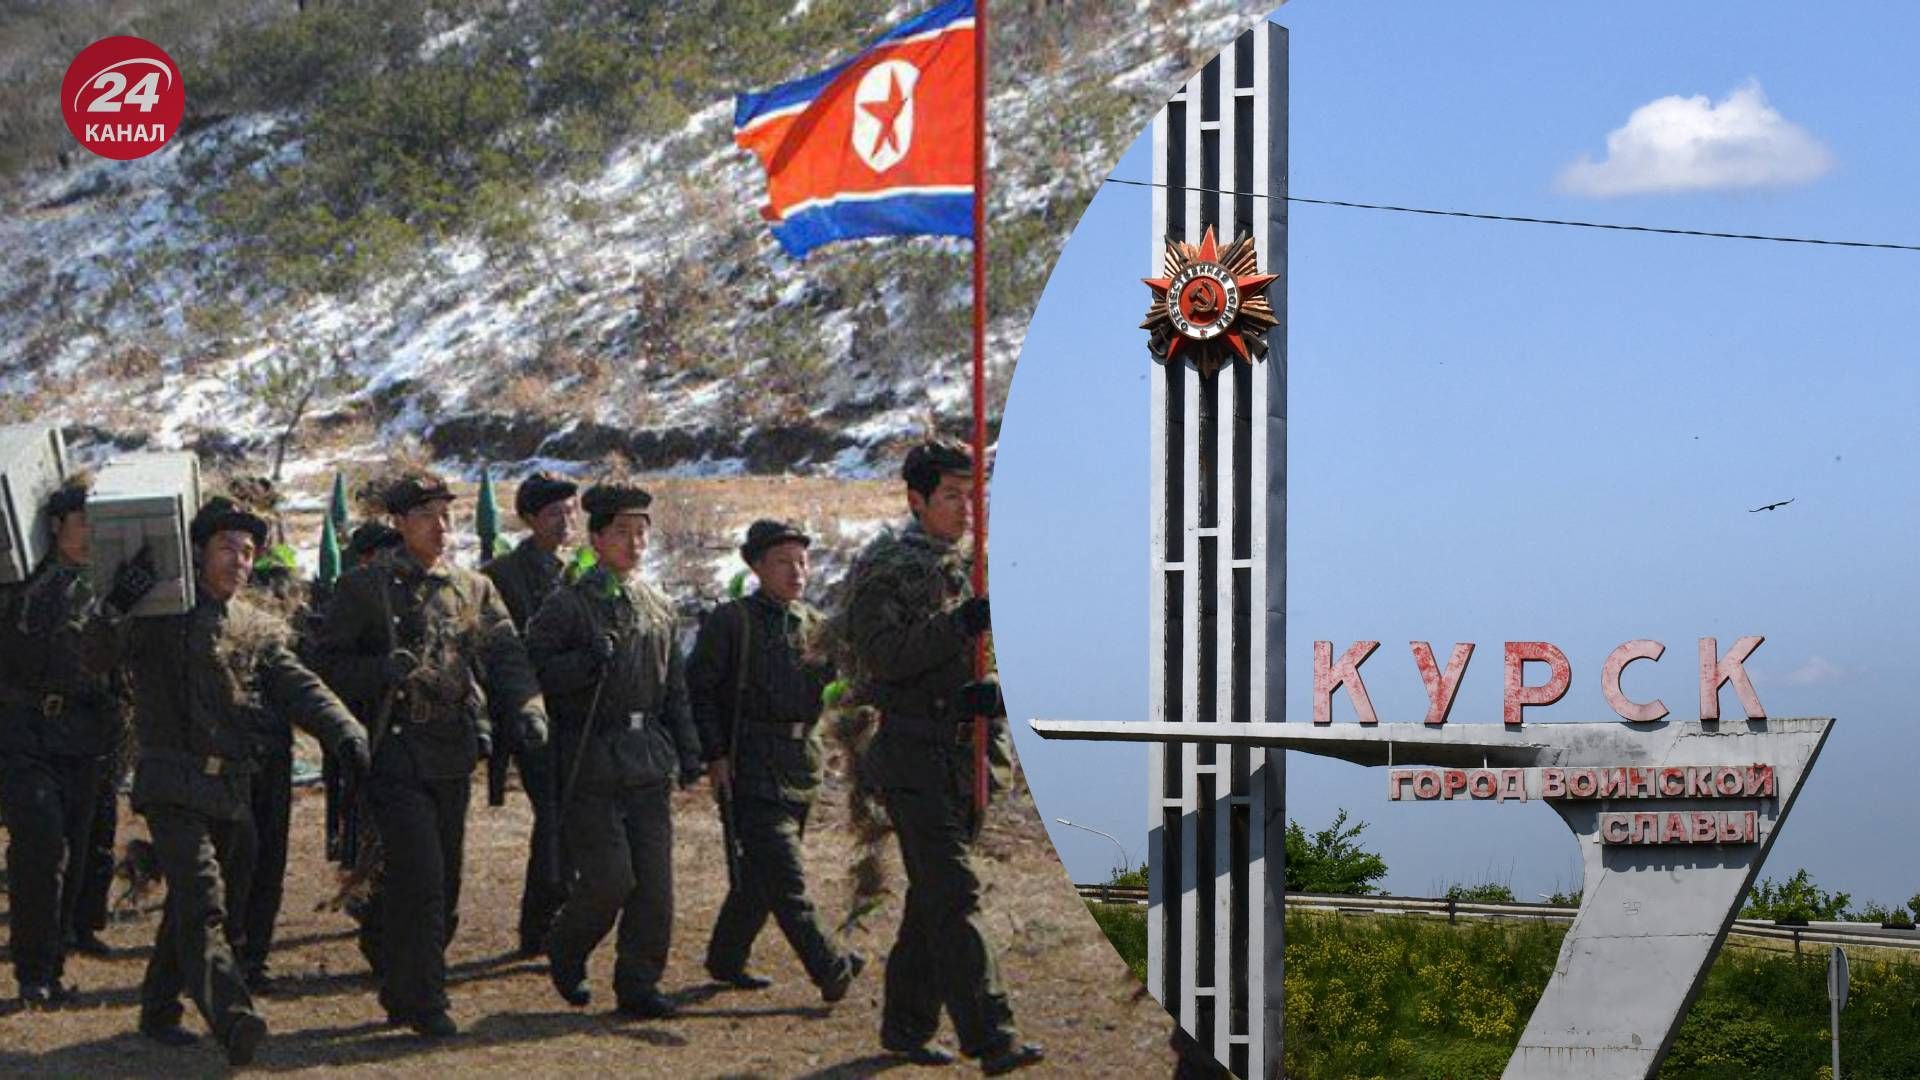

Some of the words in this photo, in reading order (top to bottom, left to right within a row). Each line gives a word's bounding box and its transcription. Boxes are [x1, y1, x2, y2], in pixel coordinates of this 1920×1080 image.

[1313, 636, 1766, 724] КУРСК
[1391, 769, 1527, 803] ГОРОД
[1542, 763, 1775, 799] ВОИНСКОЙ
[1603, 811, 1757, 843] СЛАВЫ
